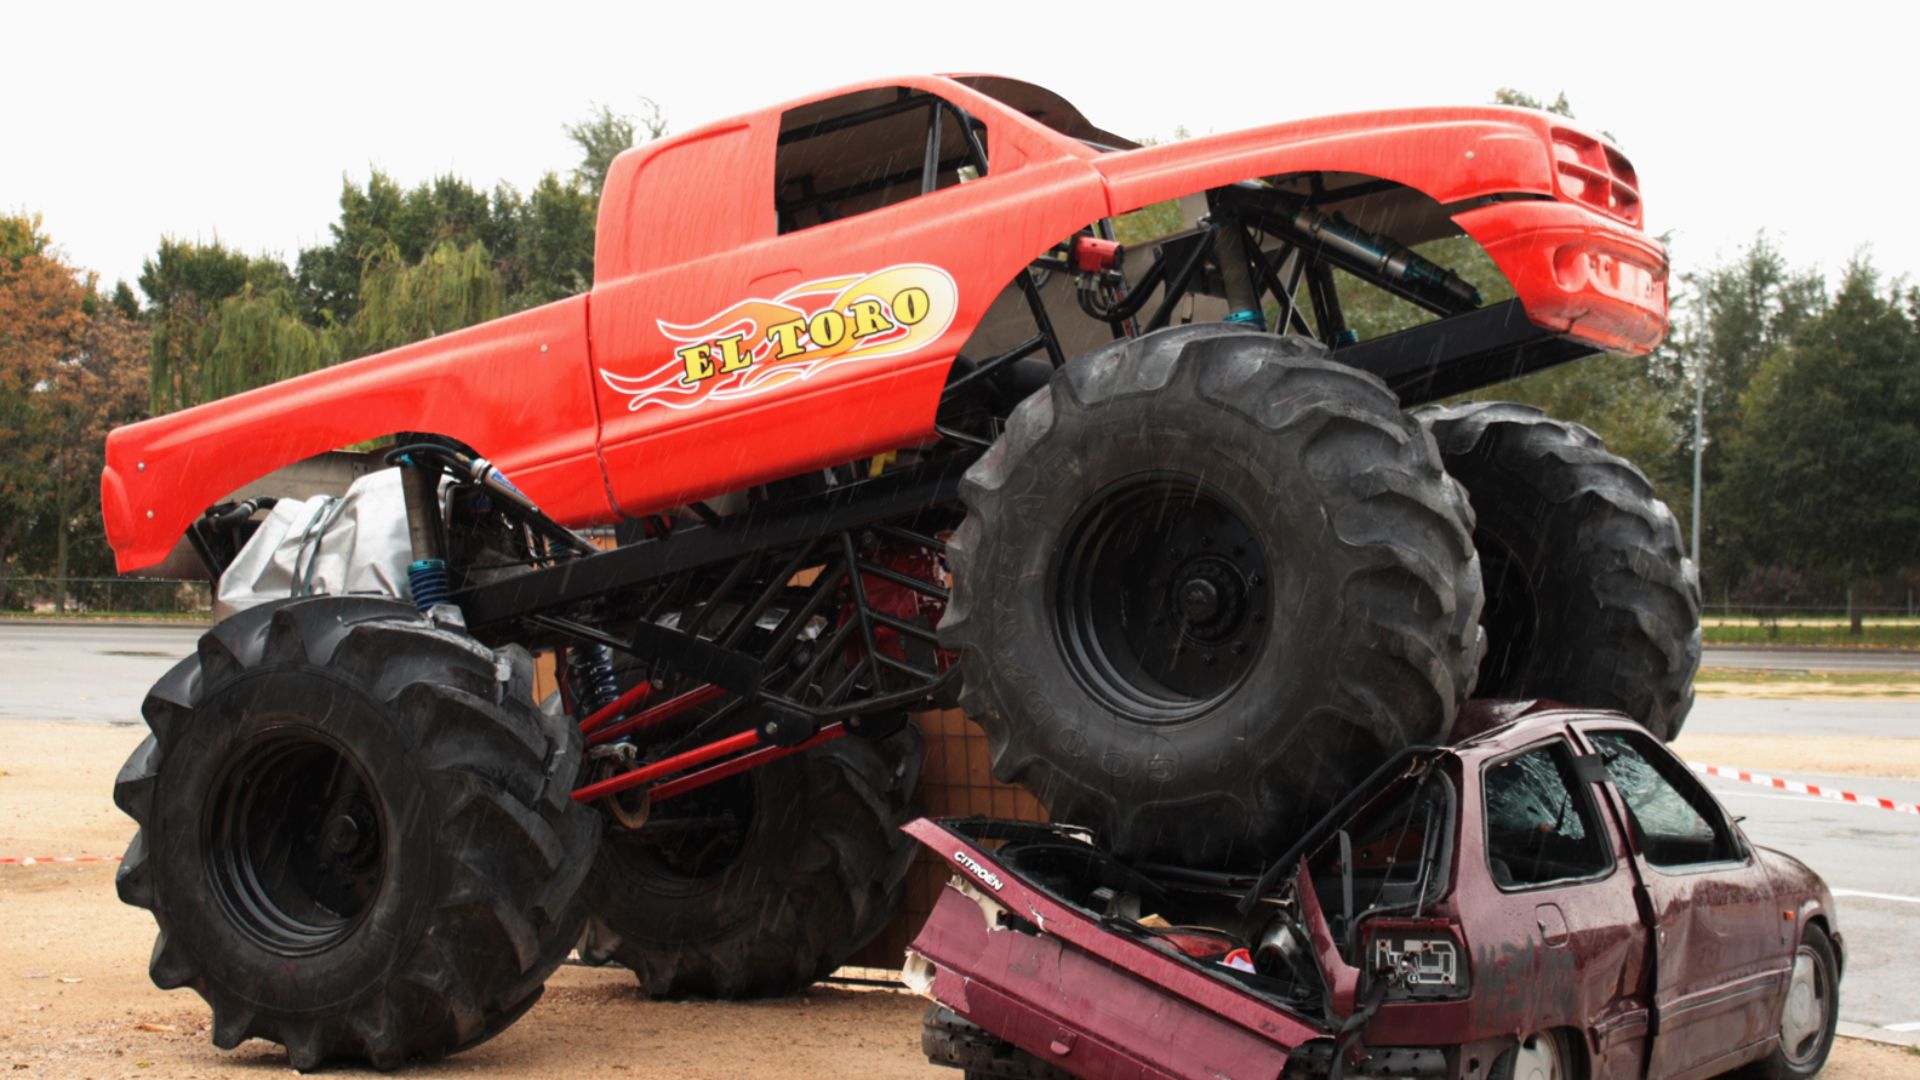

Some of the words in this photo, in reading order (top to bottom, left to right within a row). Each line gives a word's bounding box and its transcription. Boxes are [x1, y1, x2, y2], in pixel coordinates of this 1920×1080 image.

[677, 333, 753, 385] EL
[767, 286, 930, 360] TORO
[953, 850, 1004, 892] CITROËN
